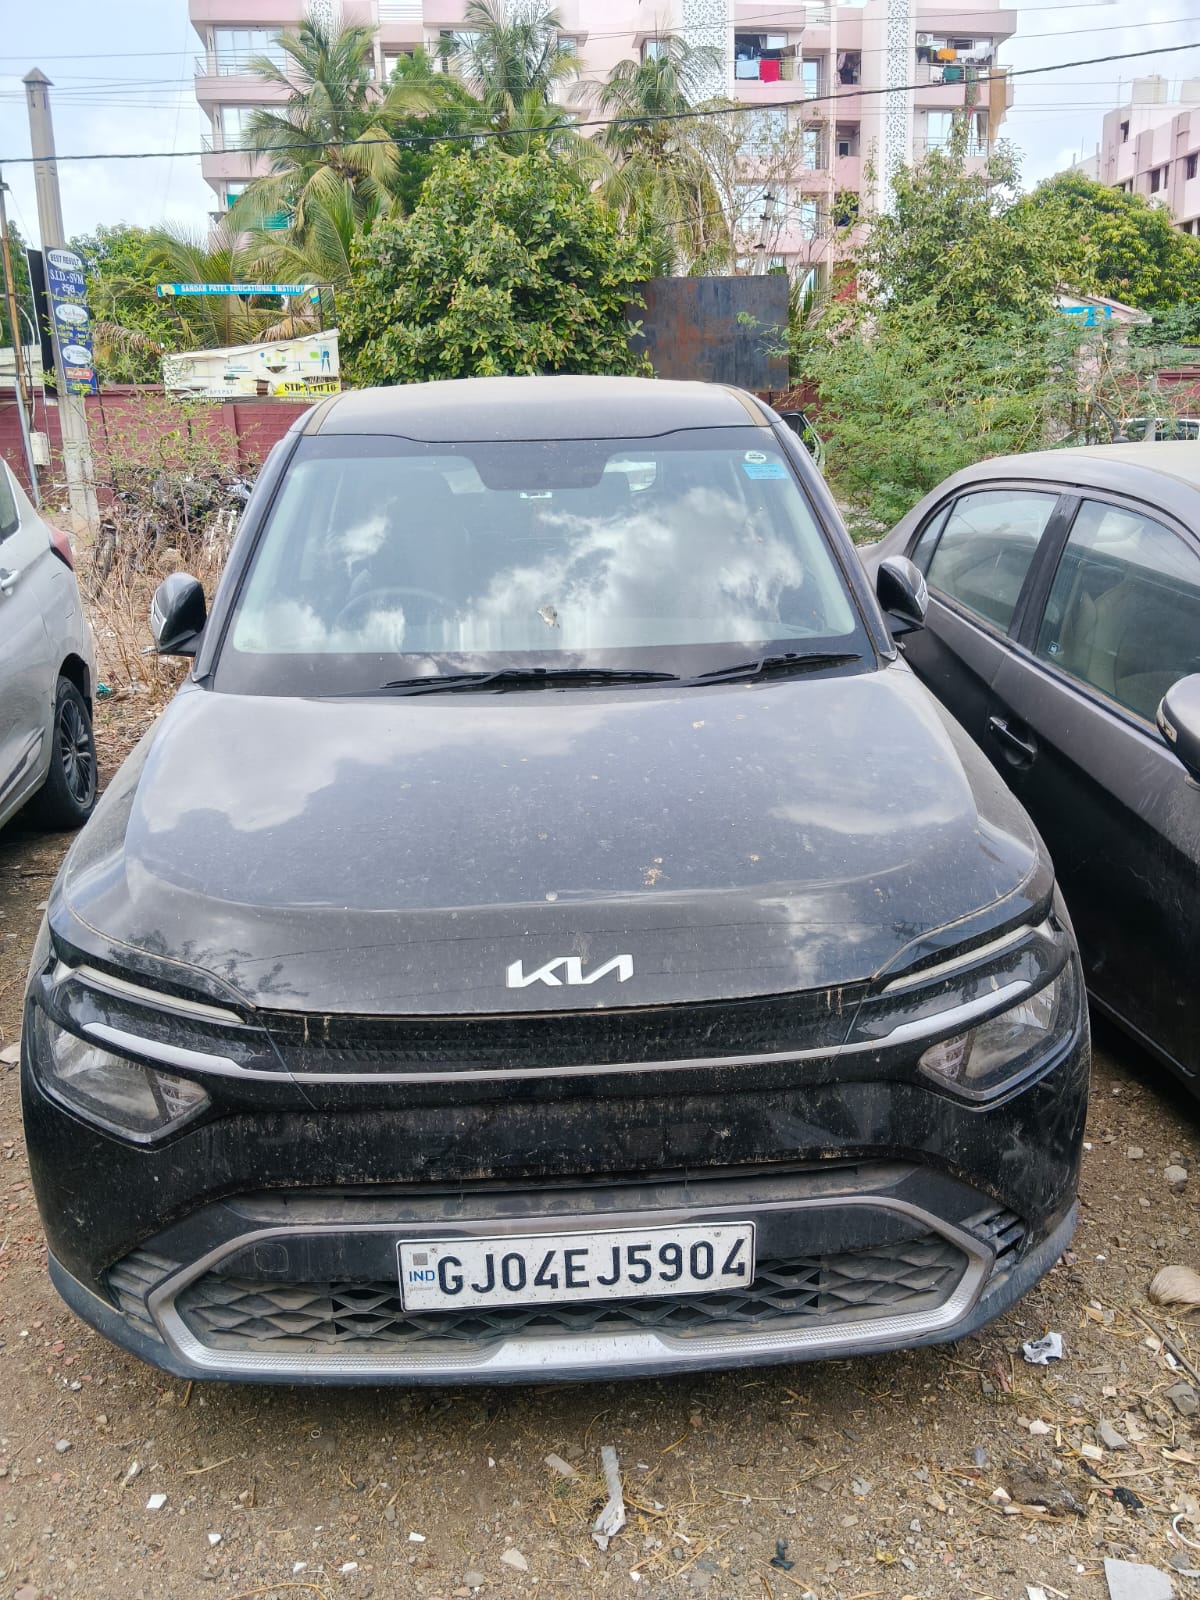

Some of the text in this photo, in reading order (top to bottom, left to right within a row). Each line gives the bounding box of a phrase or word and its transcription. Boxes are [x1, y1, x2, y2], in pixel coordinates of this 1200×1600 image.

[506, 954, 634, 988] KIA
[409, 1270, 435, 1282] IND
[438, 1238, 746, 1295] GJ04EJ5904
